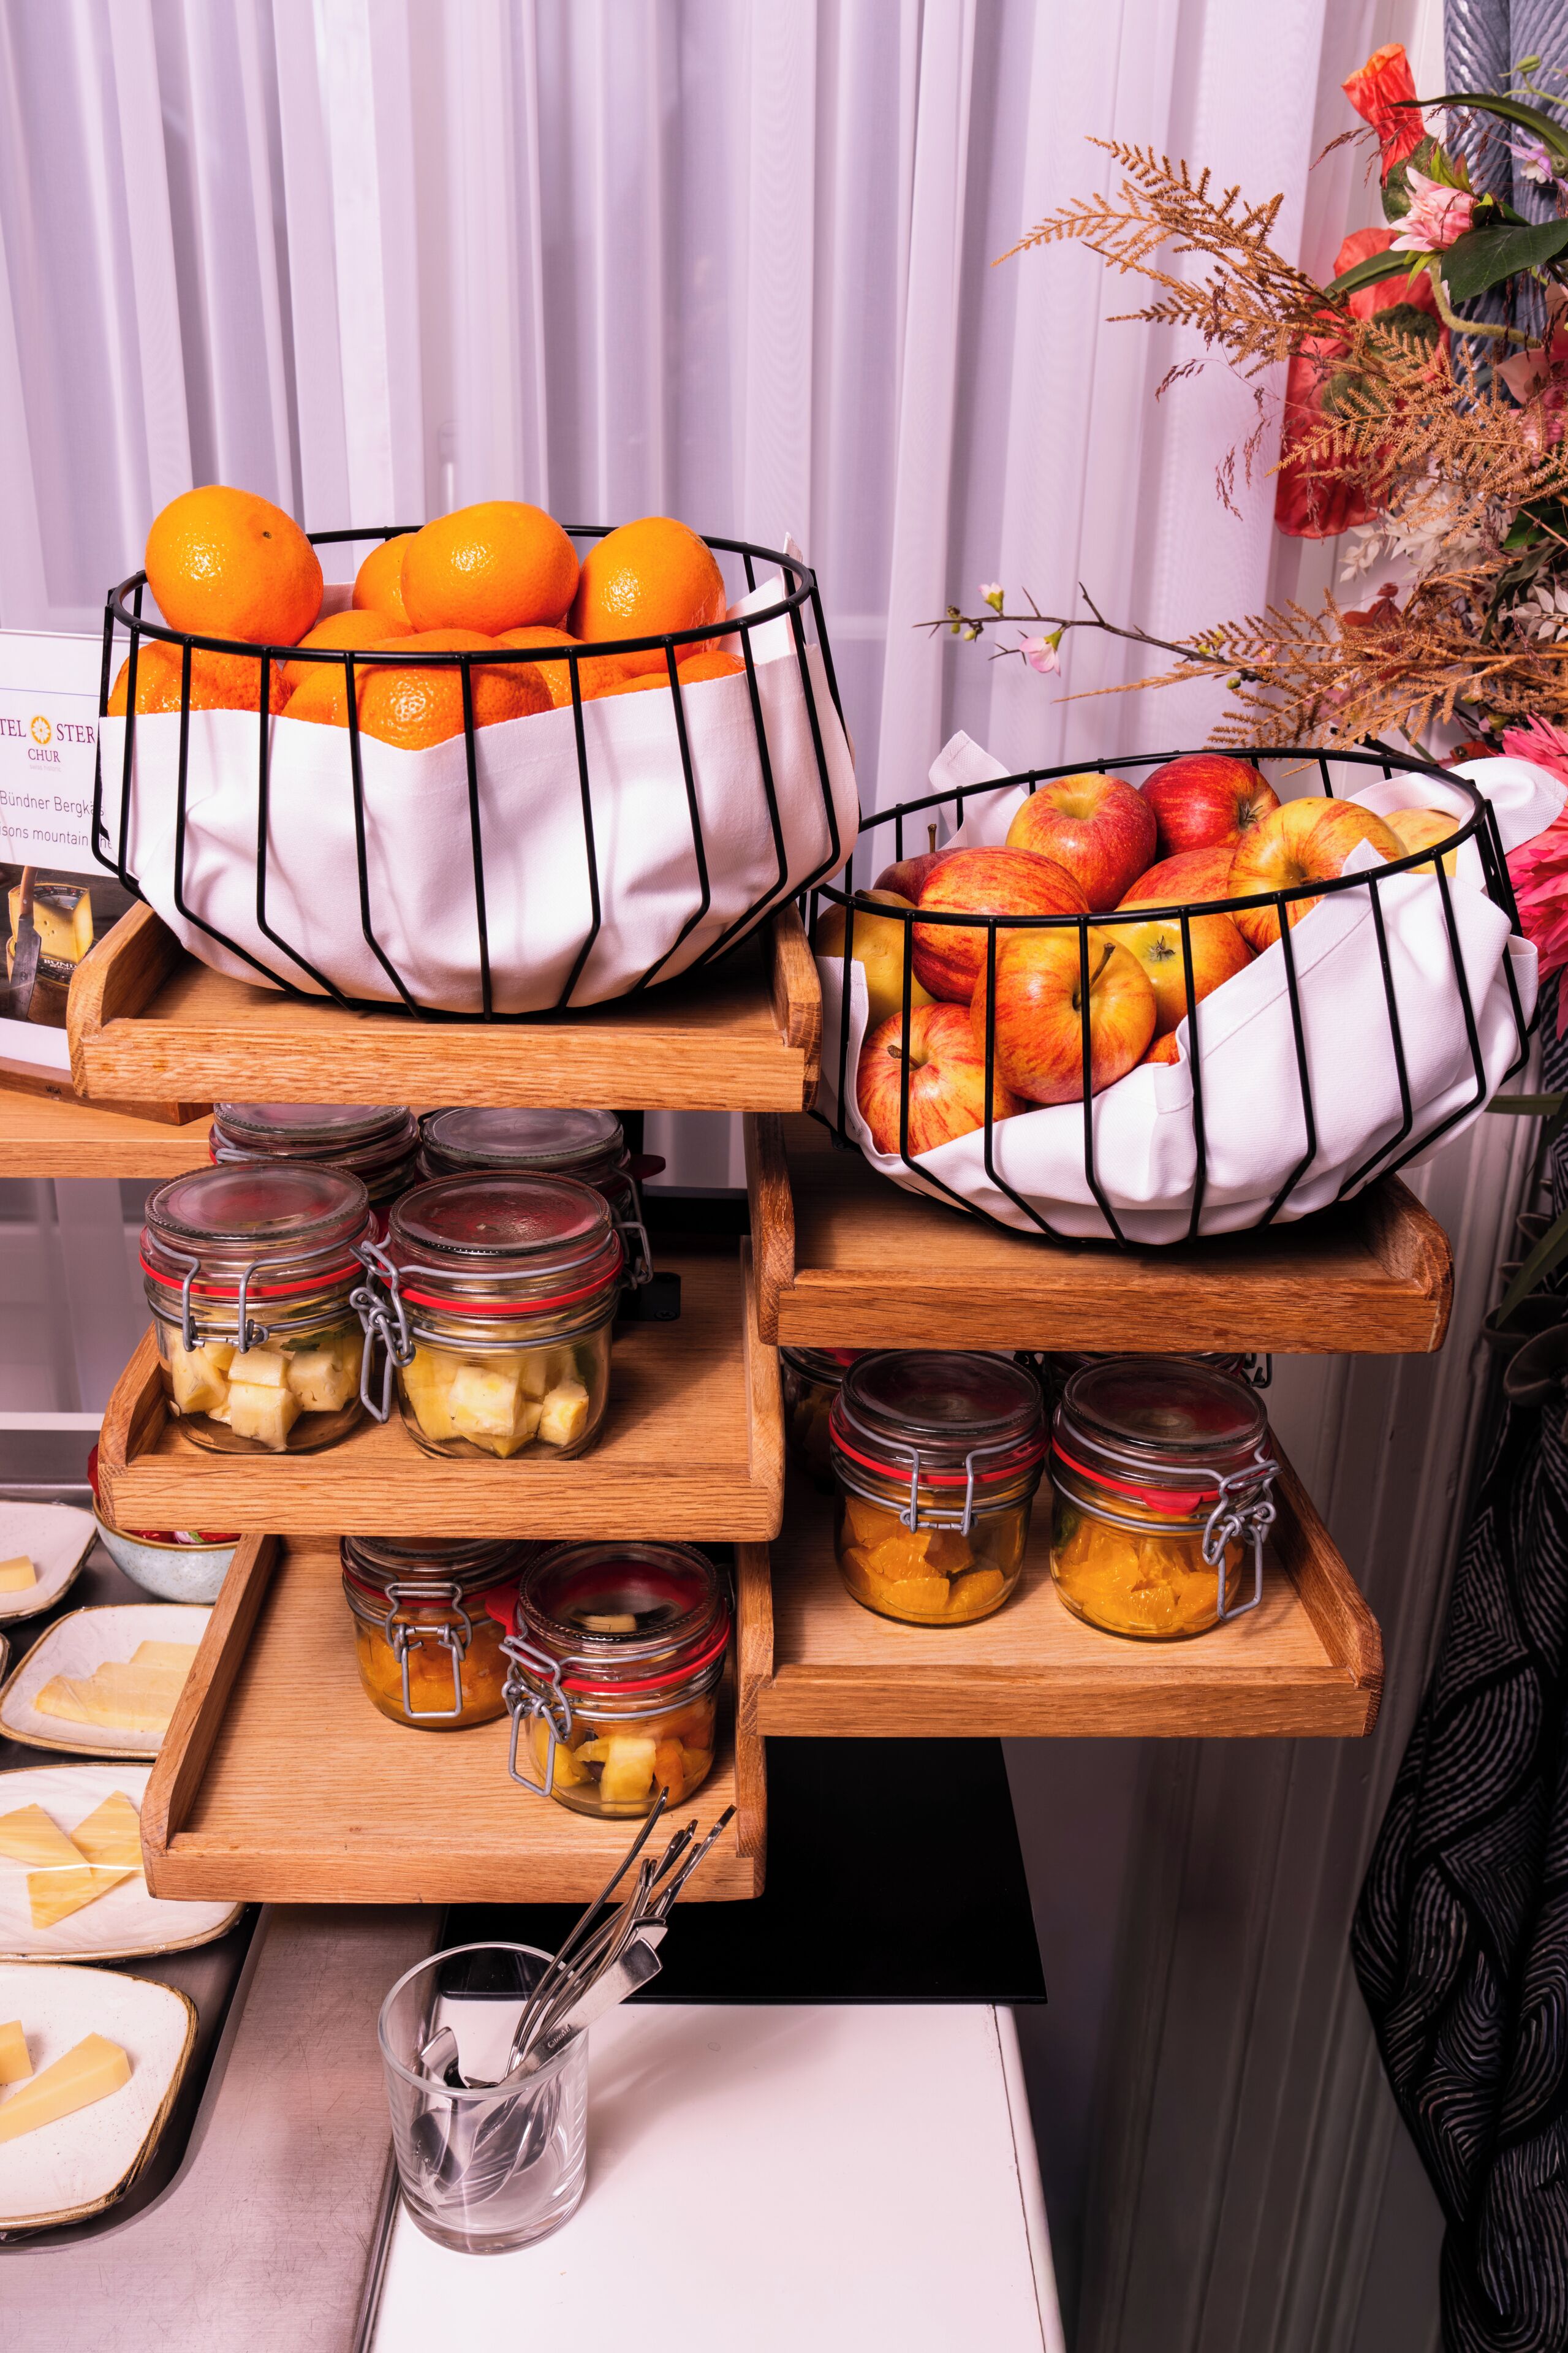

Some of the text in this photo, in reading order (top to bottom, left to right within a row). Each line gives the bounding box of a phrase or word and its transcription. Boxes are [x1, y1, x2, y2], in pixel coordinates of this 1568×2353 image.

[0, 719, 96, 743] TEL STER
[28, 748, 61, 762] CHUR
[0, 790, 50, 809] Bündner
[33, 829, 88, 846] mountain
